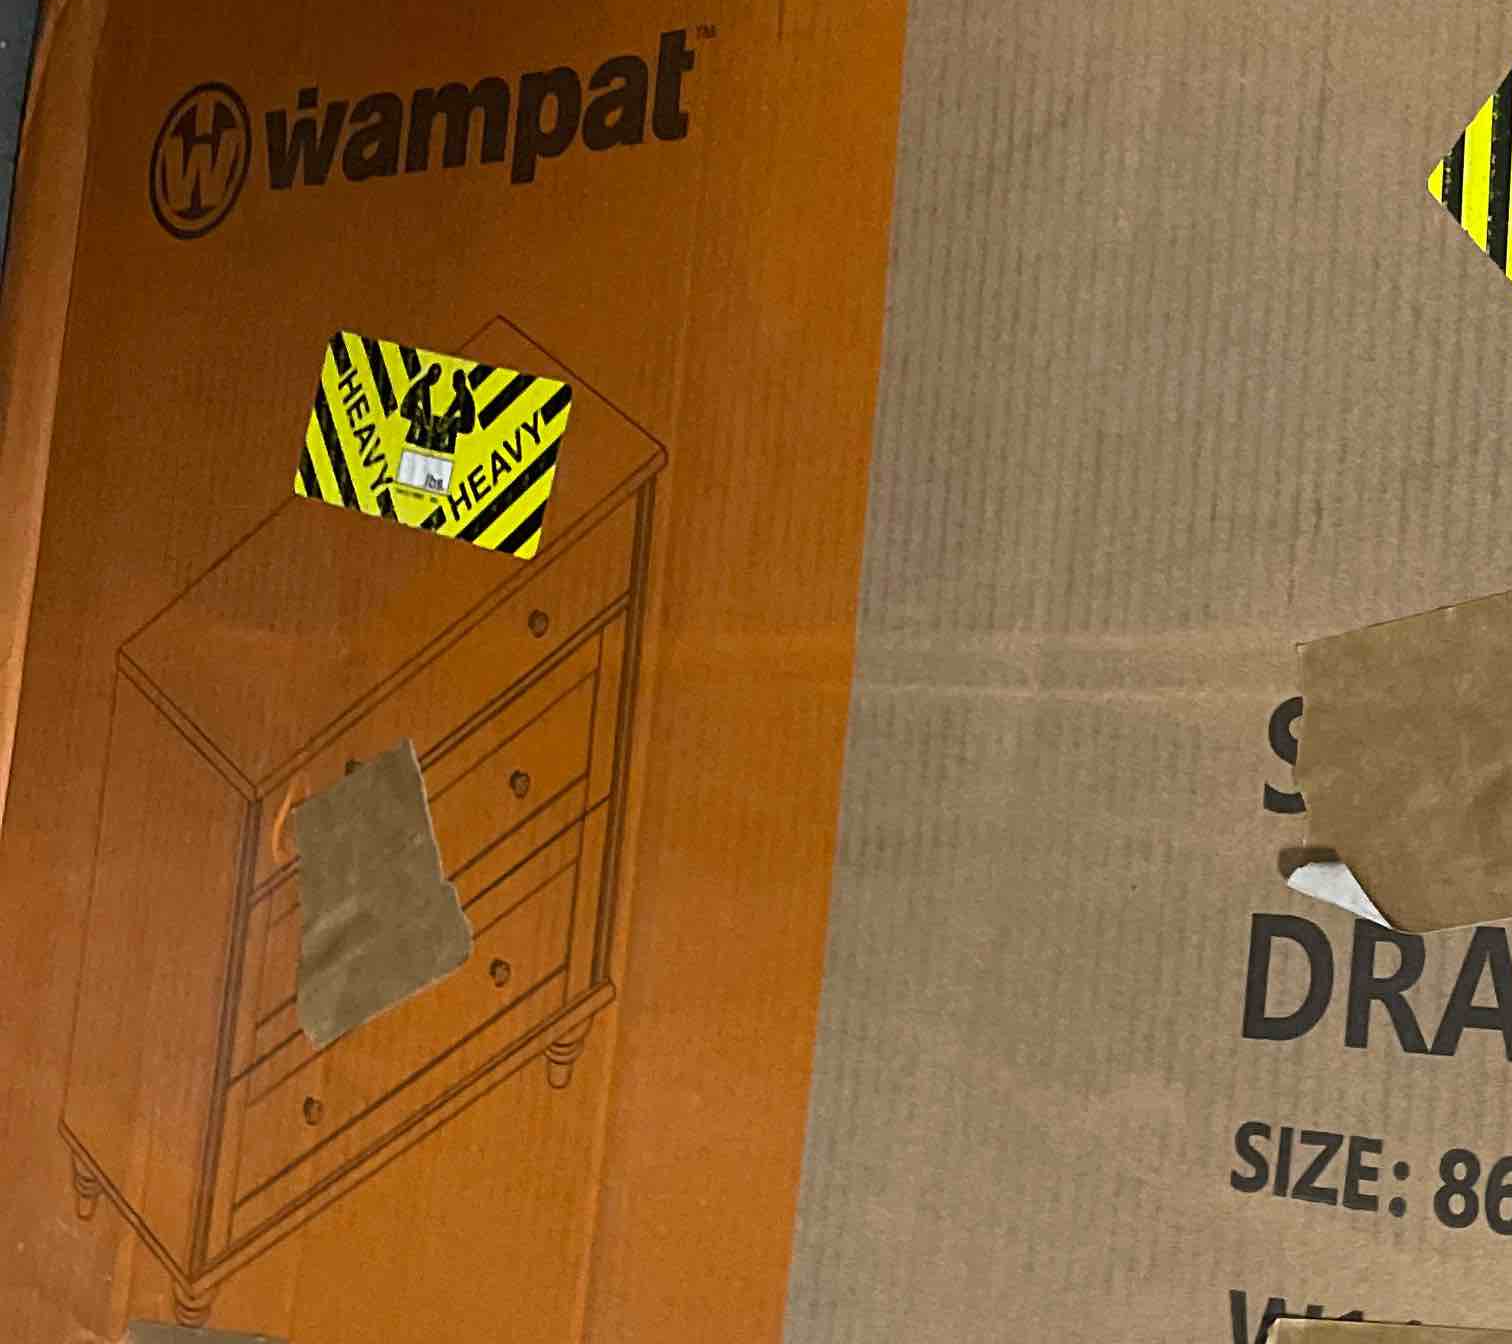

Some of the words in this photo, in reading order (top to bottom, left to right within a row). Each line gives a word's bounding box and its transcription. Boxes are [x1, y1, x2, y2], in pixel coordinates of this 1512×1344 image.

[338, 368, 394, 491] HEAVY
[448, 409, 542, 522] HEAVY
[1230, 1121, 1409, 1218] SIZE:
